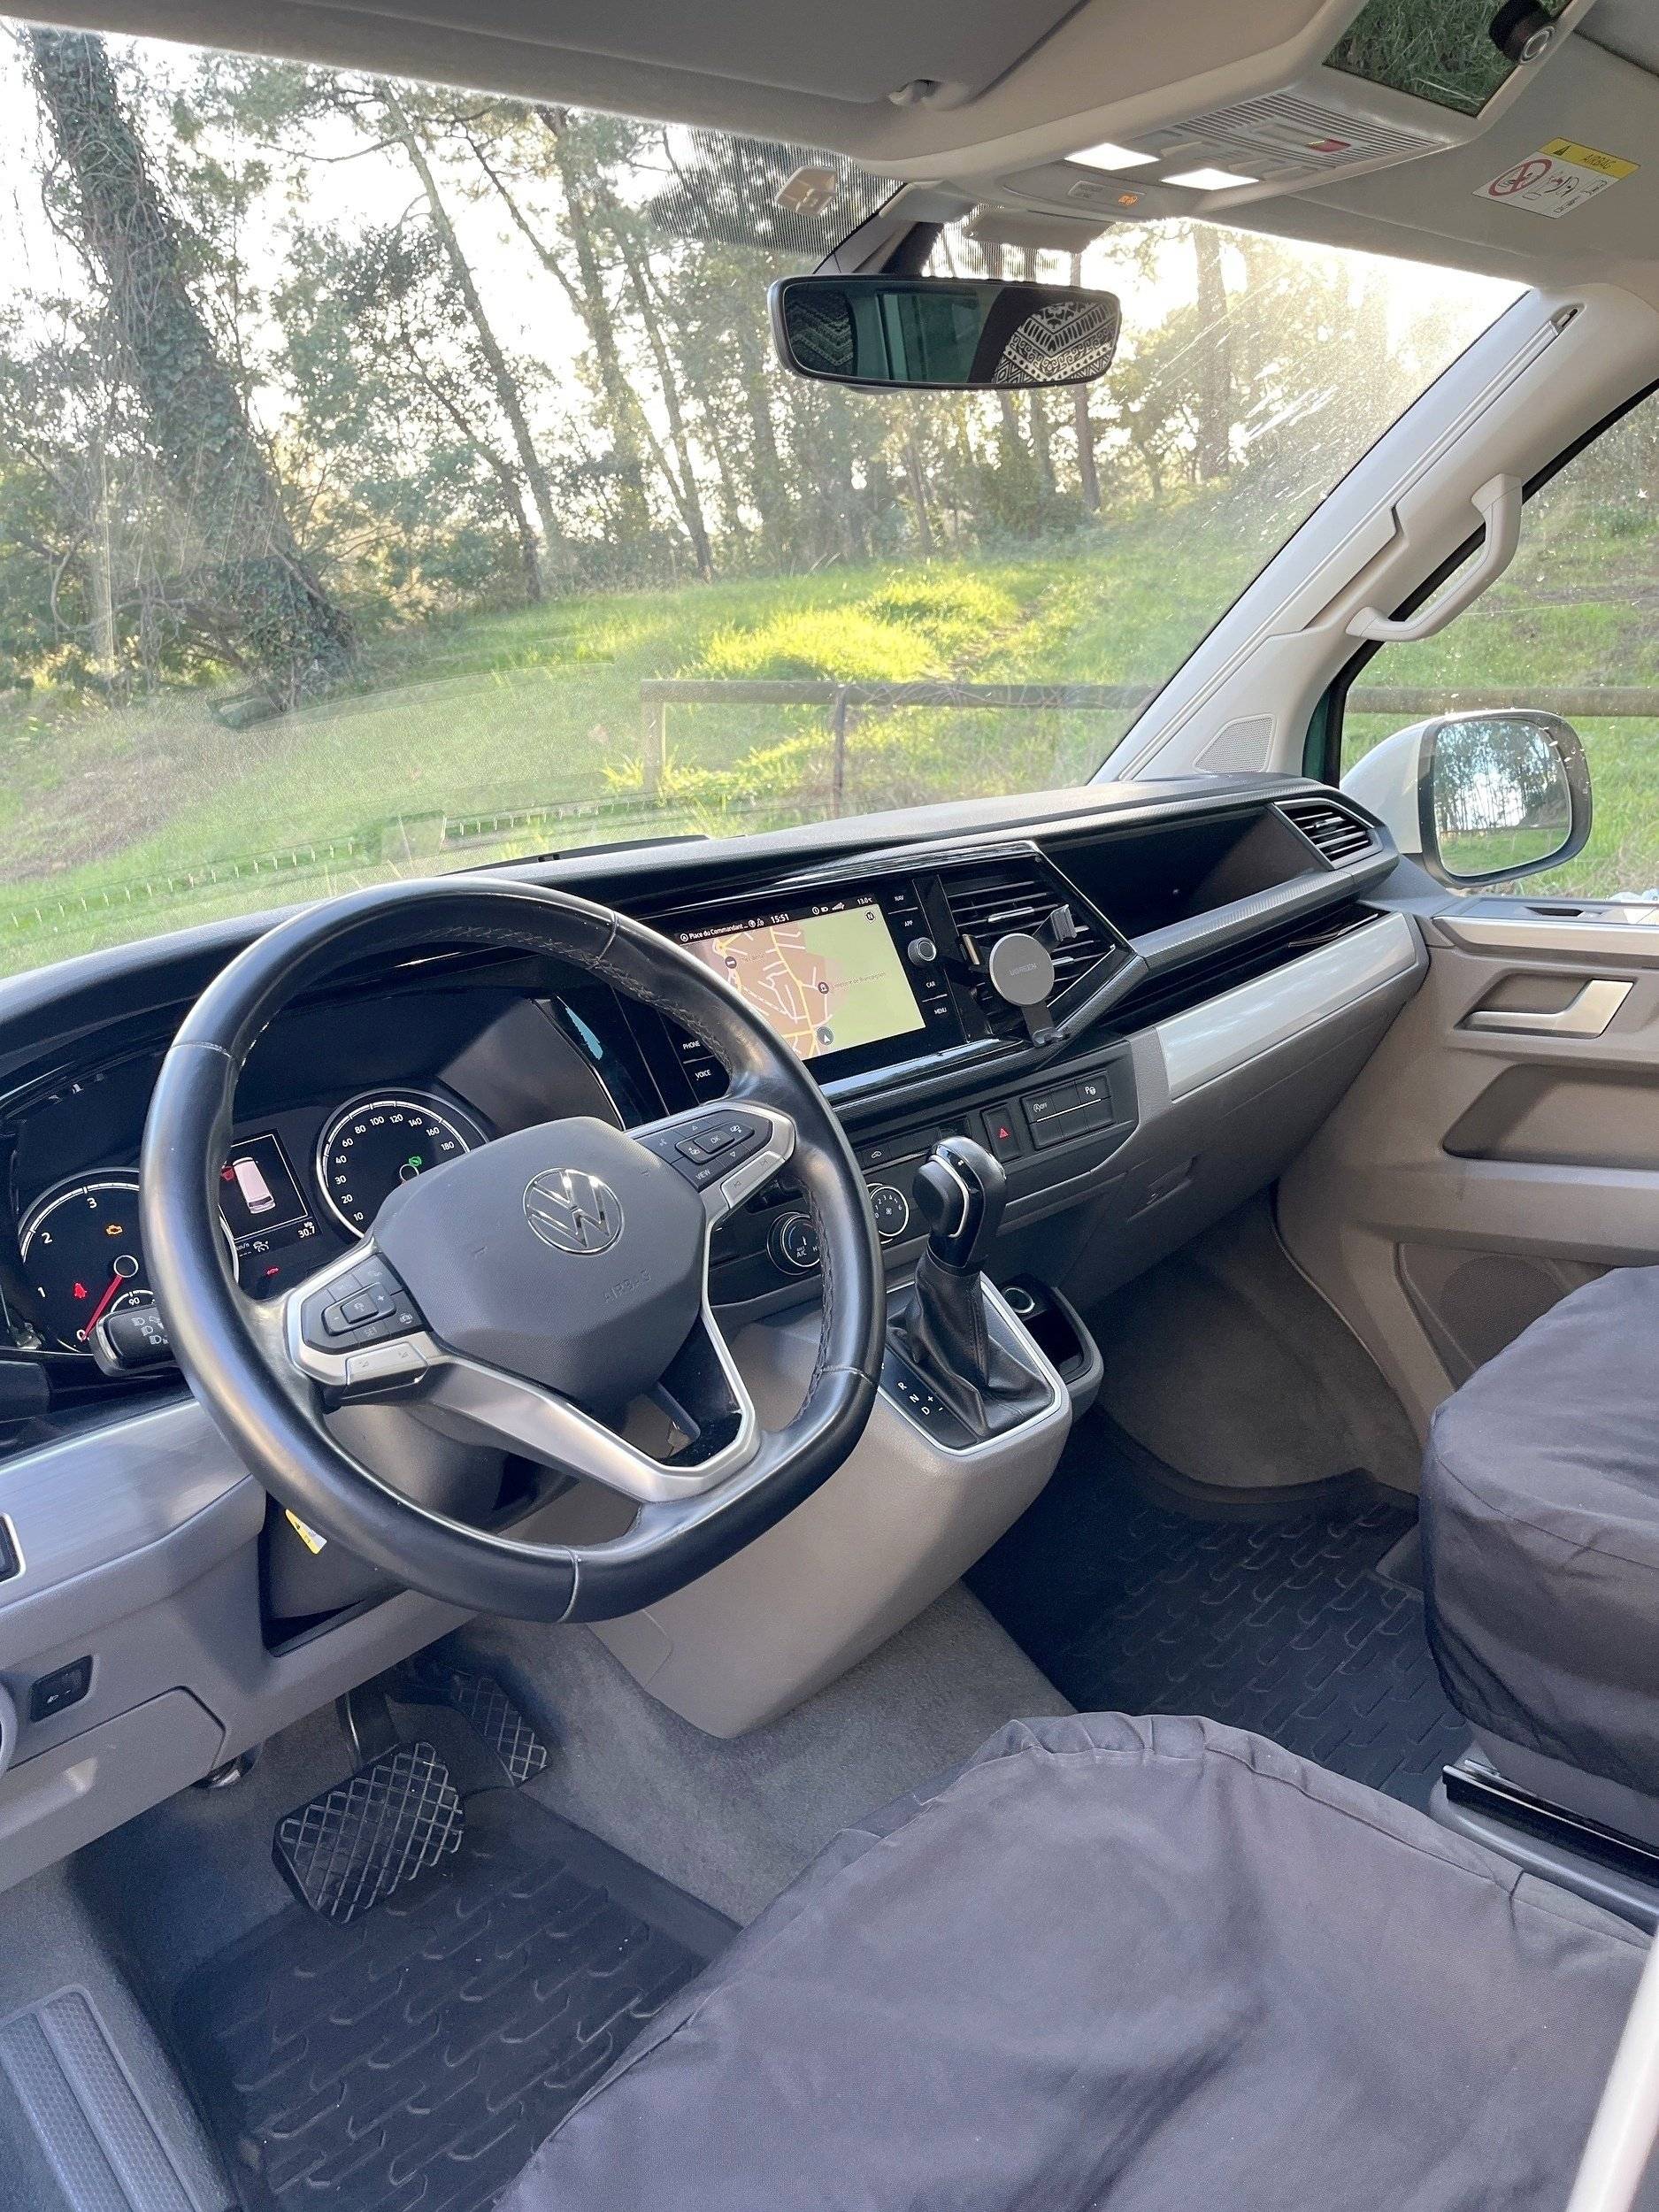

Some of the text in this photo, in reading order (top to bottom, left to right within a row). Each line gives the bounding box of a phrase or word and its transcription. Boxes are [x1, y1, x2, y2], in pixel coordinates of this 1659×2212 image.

[770, 913, 789, 924] 15:51
[688, 929, 703, 940] Place
[710, 922, 743, 936] Commandant
[682, 1040, 701, 1050] PHONE
[695, 1069, 711, 1079] VOICE
[370, 1116, 385, 1126] 100
[389, 1113, 403, 1124] 120
[408, 1117, 422, 1127] 140
[354, 1125, 366, 1134] 80
[426, 1126, 441, 1137] 160
[342, 1138, 354, 1148] 60
[441, 1141, 455, 1151] 180
[335, 1155, 347, 1164] 40
[695, 1169, 710, 1180] VIEW
[334, 1175, 347, 1185] 30
[87, 1197, 97, 1209] 3
[342, 1194, 353, 1204] 20
[354, 1211, 364, 1221] 10
[297, 1225, 316, 1239] 30.7
[42, 1232, 53, 1244] 2
[37, 1286, 46, 1298] 1
[128, 1297, 141, 1306] 90
[897, 1381, 908, 1391] R
[909, 1394, 920, 1403] N
[921, 1406, 930, 1416] D
